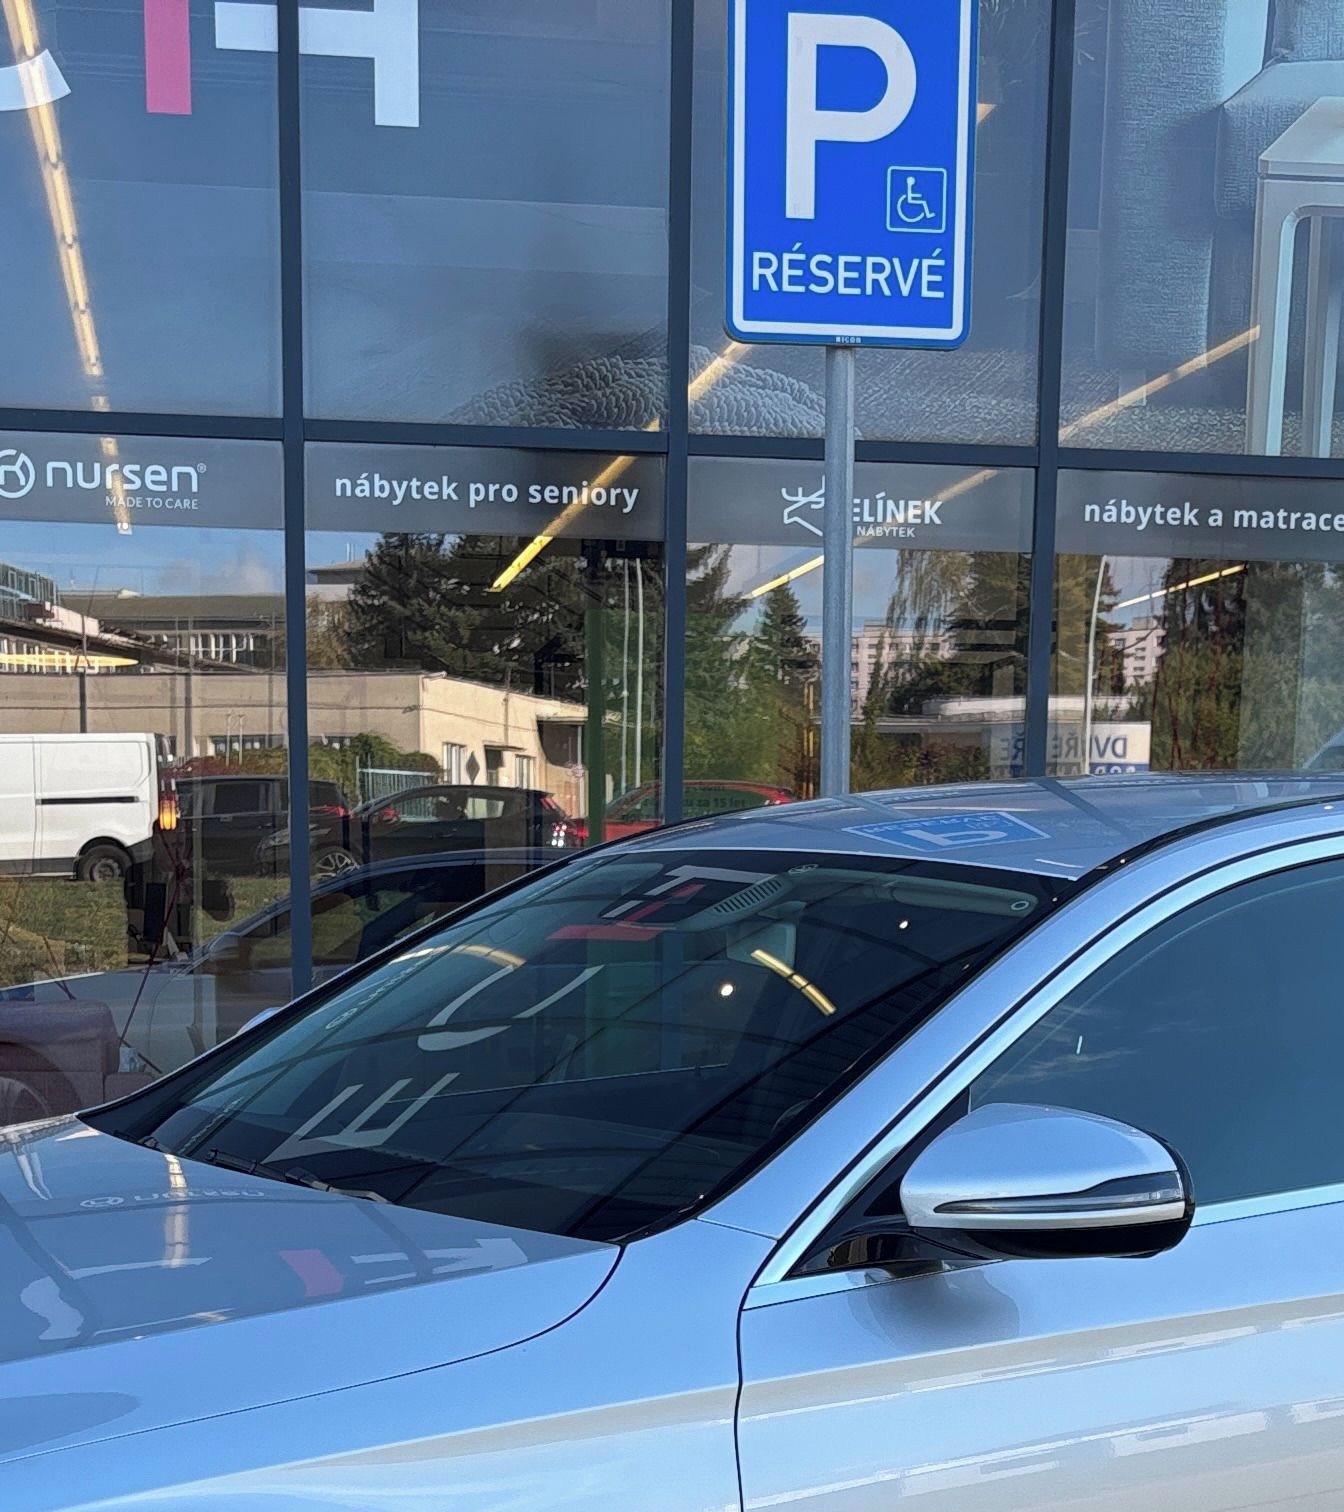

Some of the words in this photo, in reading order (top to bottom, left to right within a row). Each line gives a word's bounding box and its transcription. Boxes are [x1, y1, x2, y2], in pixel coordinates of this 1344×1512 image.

[785, 12, 917, 220] P
[752, 242, 945, 298] RÉSERVÉ
[46, 460, 199, 493] nursen
[335, 471, 458, 506] nábytek
[469, 482, 519, 508] pro
[528, 481, 640, 513] seniory
[105, 496, 143, 508] MADE
[145, 497, 163, 509] TO
[164, 497, 199, 510] CARE
[853, 491, 943, 525] ELÍNEK
[1084, 498, 1200, 530] nábytek
[1207, 508, 1224, 527] a
[856, 524, 916, 538] NÁBYTEK
